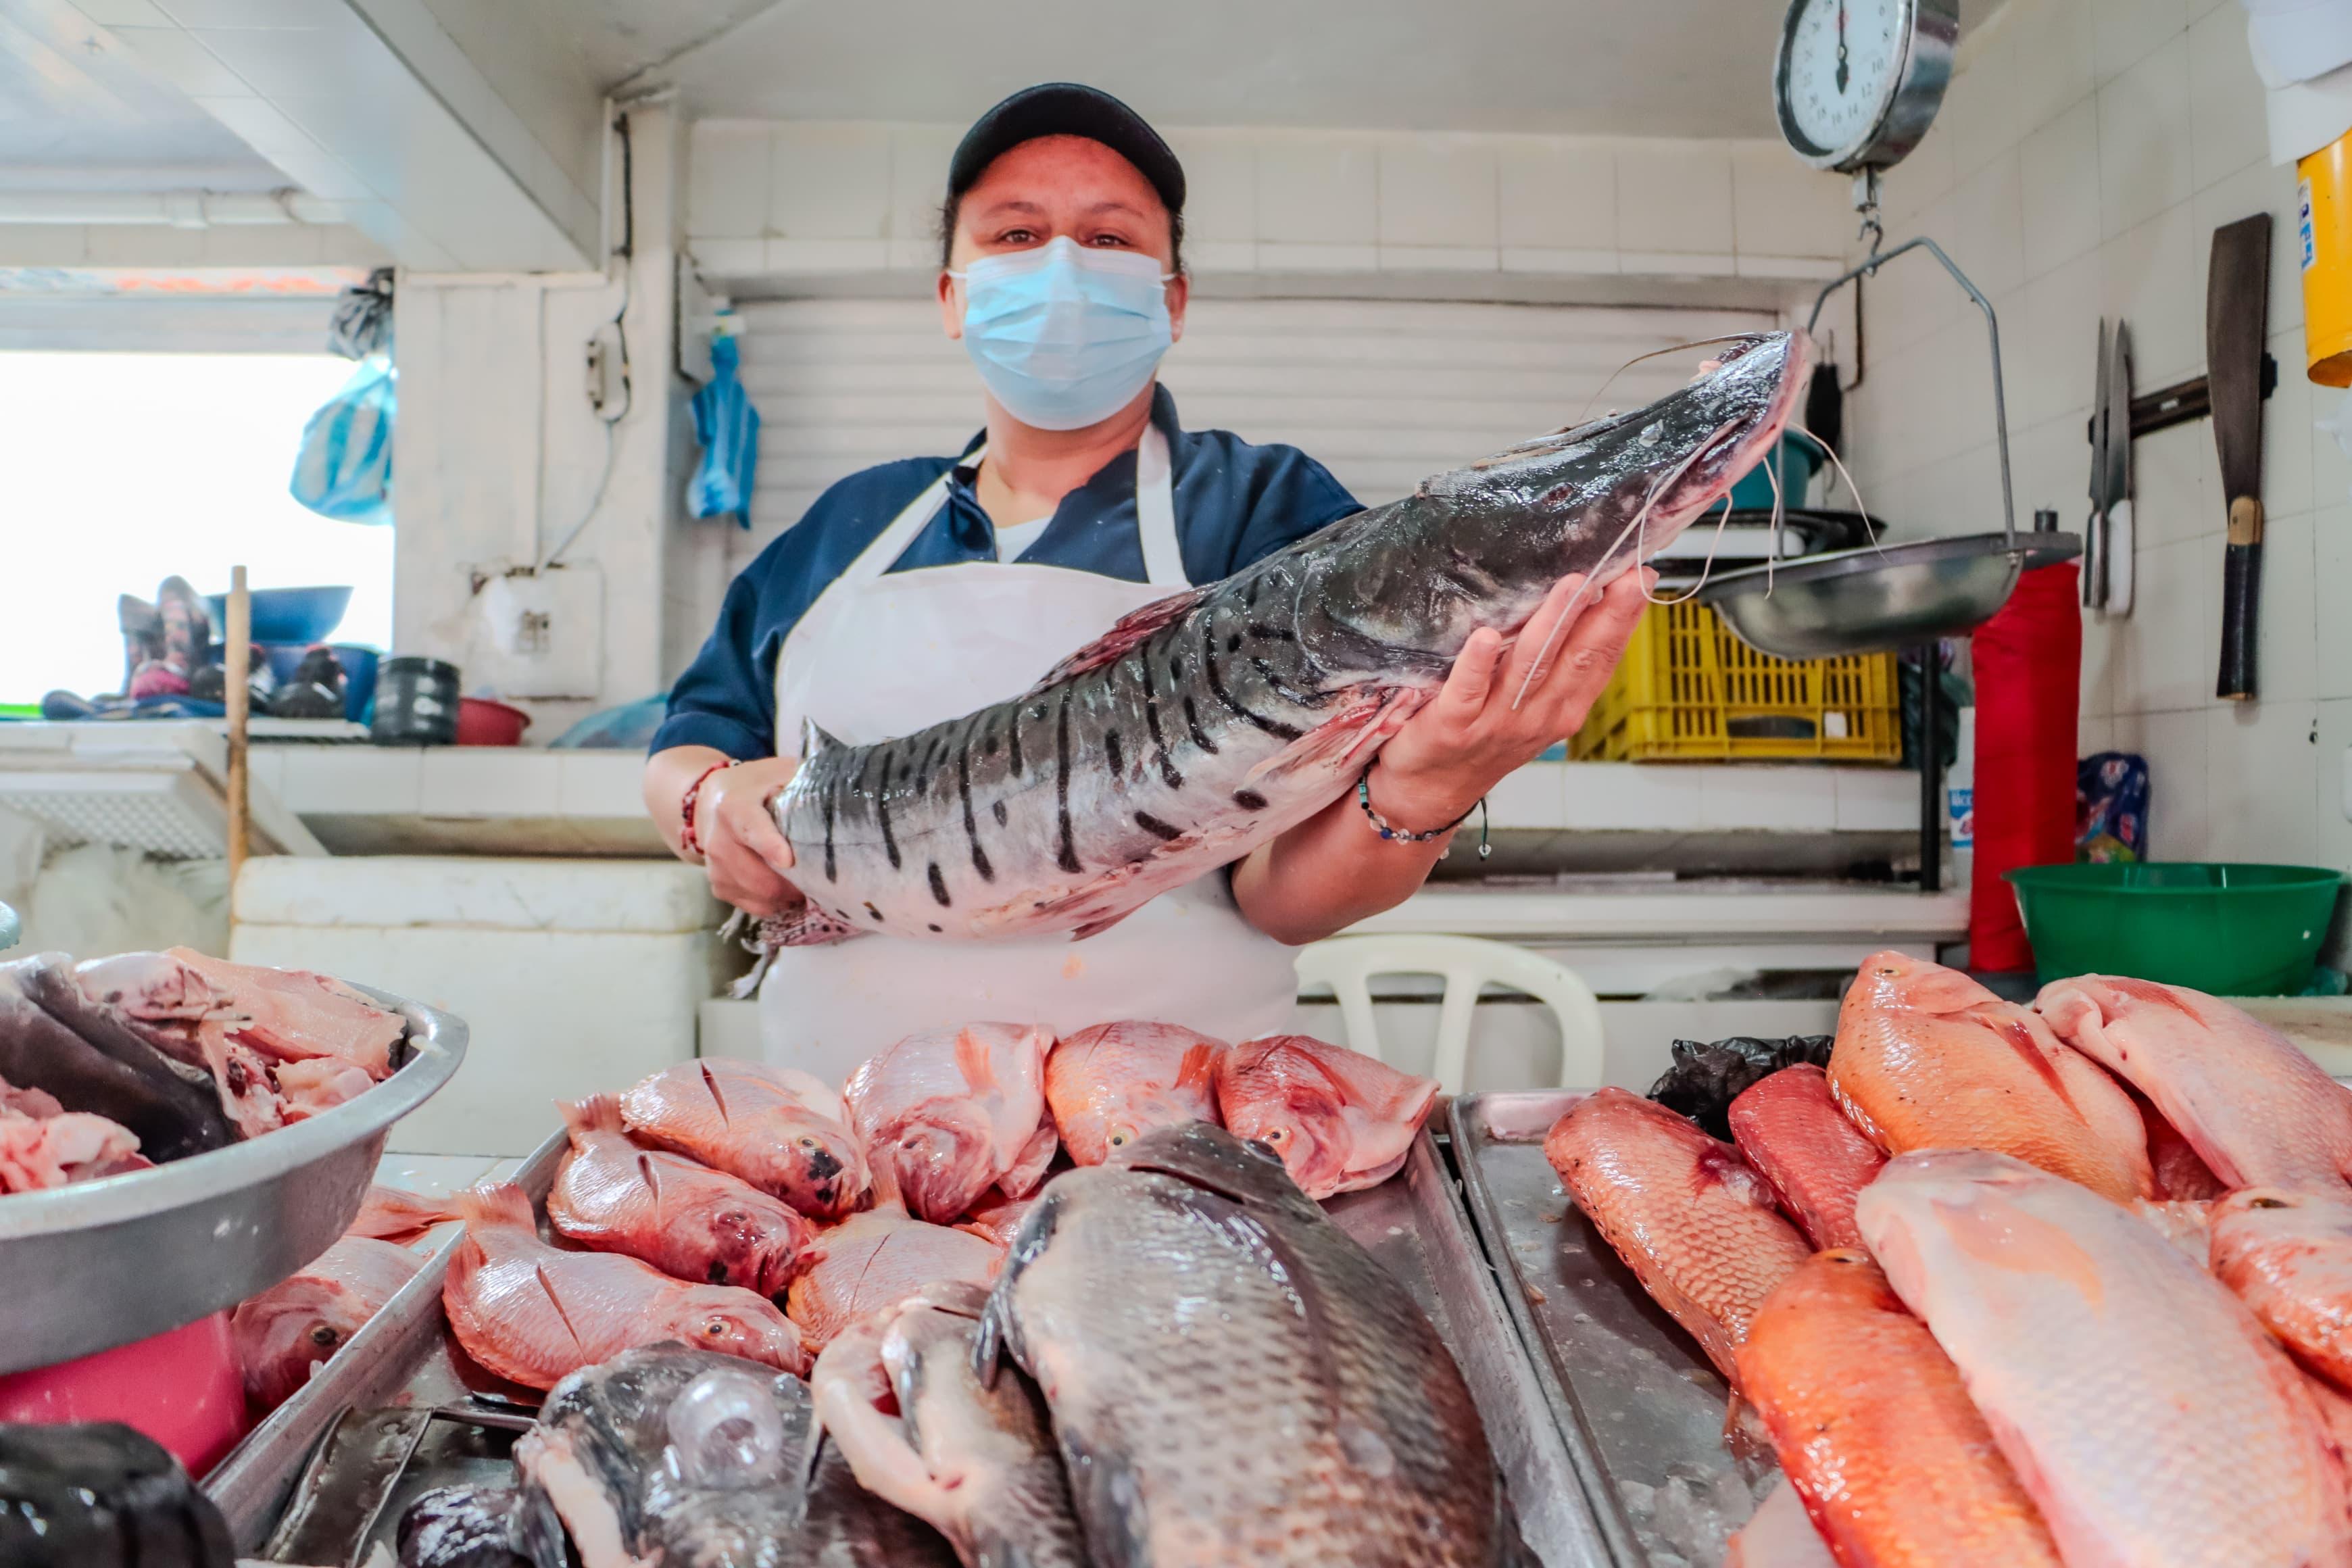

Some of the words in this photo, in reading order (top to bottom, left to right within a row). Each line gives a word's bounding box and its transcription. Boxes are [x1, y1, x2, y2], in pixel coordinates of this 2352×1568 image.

[1872, 57, 1884, 74] 10
[1861, 82, 1872, 99] 12
[1817, 105, 1828, 122] 18
[1832, 111, 1842, 126] 16
[1848, 102, 1859, 119] 14
